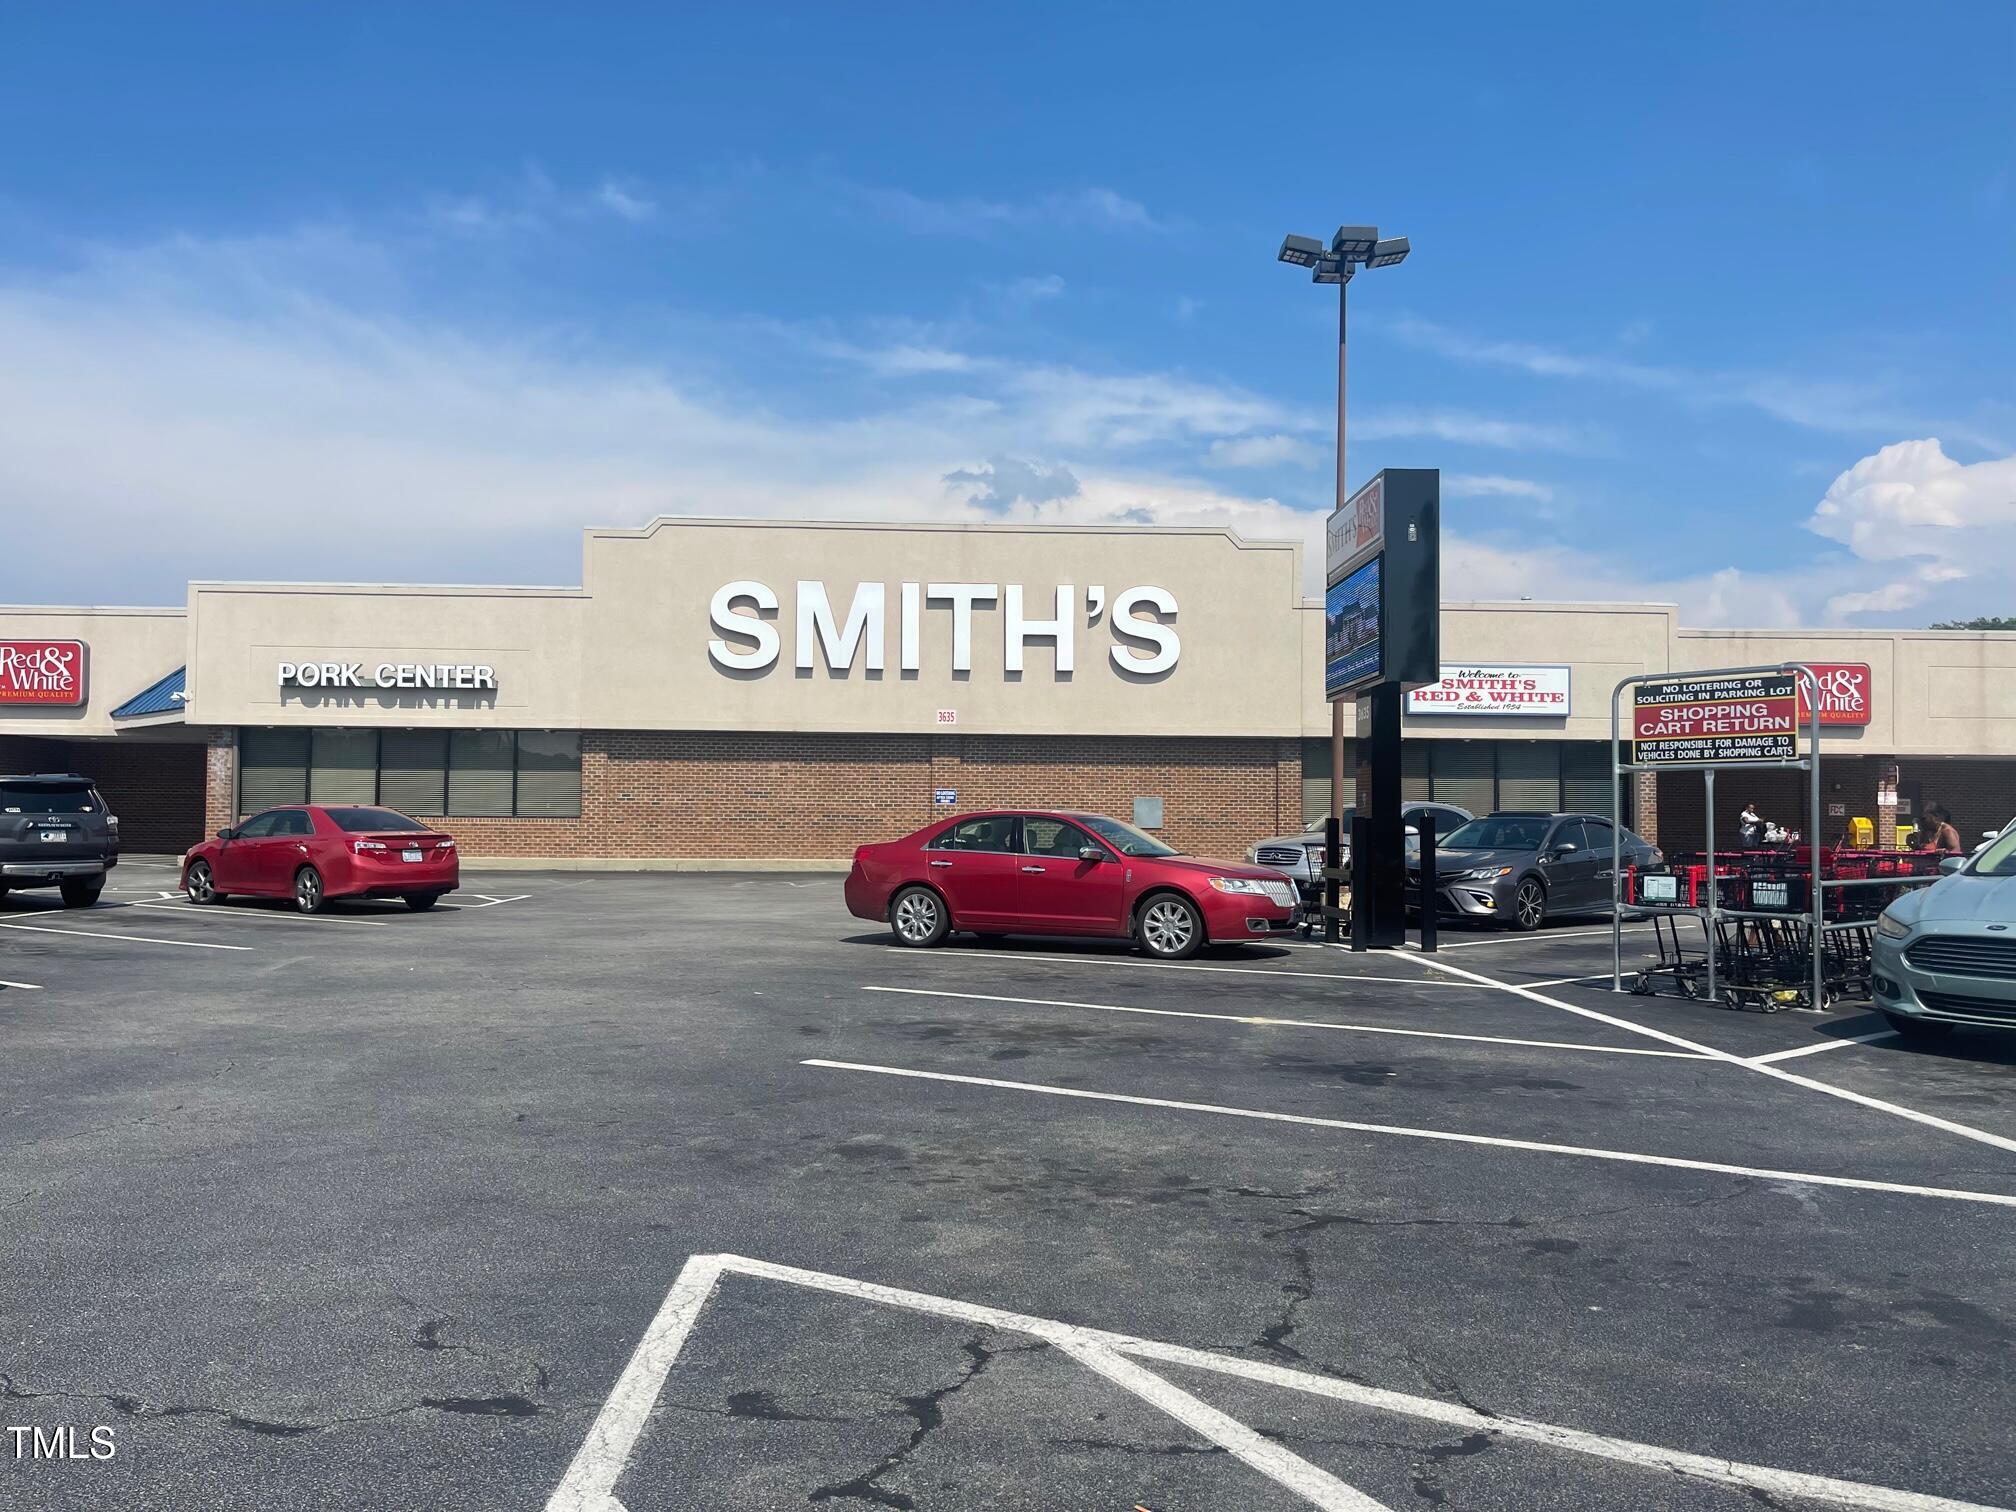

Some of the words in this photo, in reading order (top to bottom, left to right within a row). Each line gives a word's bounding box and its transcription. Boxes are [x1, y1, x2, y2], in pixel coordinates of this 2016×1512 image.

[707, 579, 1181, 674] SMITH'S
[10, 668, 73, 690] White
[278, 662, 362, 687] PORK
[374, 664, 495, 688] CENTER
[1458, 669, 1505, 678] Welcome
[1508, 671, 1519, 679] to
[1441, 679, 1537, 690] SMITH'S
[1662, 685, 1679, 694] NO
[1683, 681, 1741, 692] LOITERING
[1745, 680, 1762, 688] OR
[1414, 691, 1460, 701] RED
[1465, 691, 1483, 702] &
[1488, 691, 1564, 703] WHITE
[1637, 693, 1694, 704] SOLICITING
[1698, 692, 1710, 700] IN
[1715, 688, 1765, 699] PARKING
[1770, 686, 1793, 695] LOT
[1802, 690, 1864, 712] White
[1456, 702, 1500, 710] Established
[1660, 703, 1768, 721] SHOPPING
[939, 711, 954, 722] 3635
[1640, 721, 1694, 736] CART
[1703, 716, 1790, 733] RETURN
[1640, 742, 1656, 751] NOT
[1659, 740, 1713, 750] RESPONSIBLE
[1715, 738, 1732, 748] FOR
[1735, 737, 1774, 747] DAMAGE
[1778, 736, 1789, 746] TO
[1638, 750, 1675, 760] VEHICLES
[1677, 749, 1701, 759] DONE
[1704, 749, 1715, 758] BY
[1718, 747, 1761, 757] SHOPPING
[1764, 746, 1793, 756] CARTS
